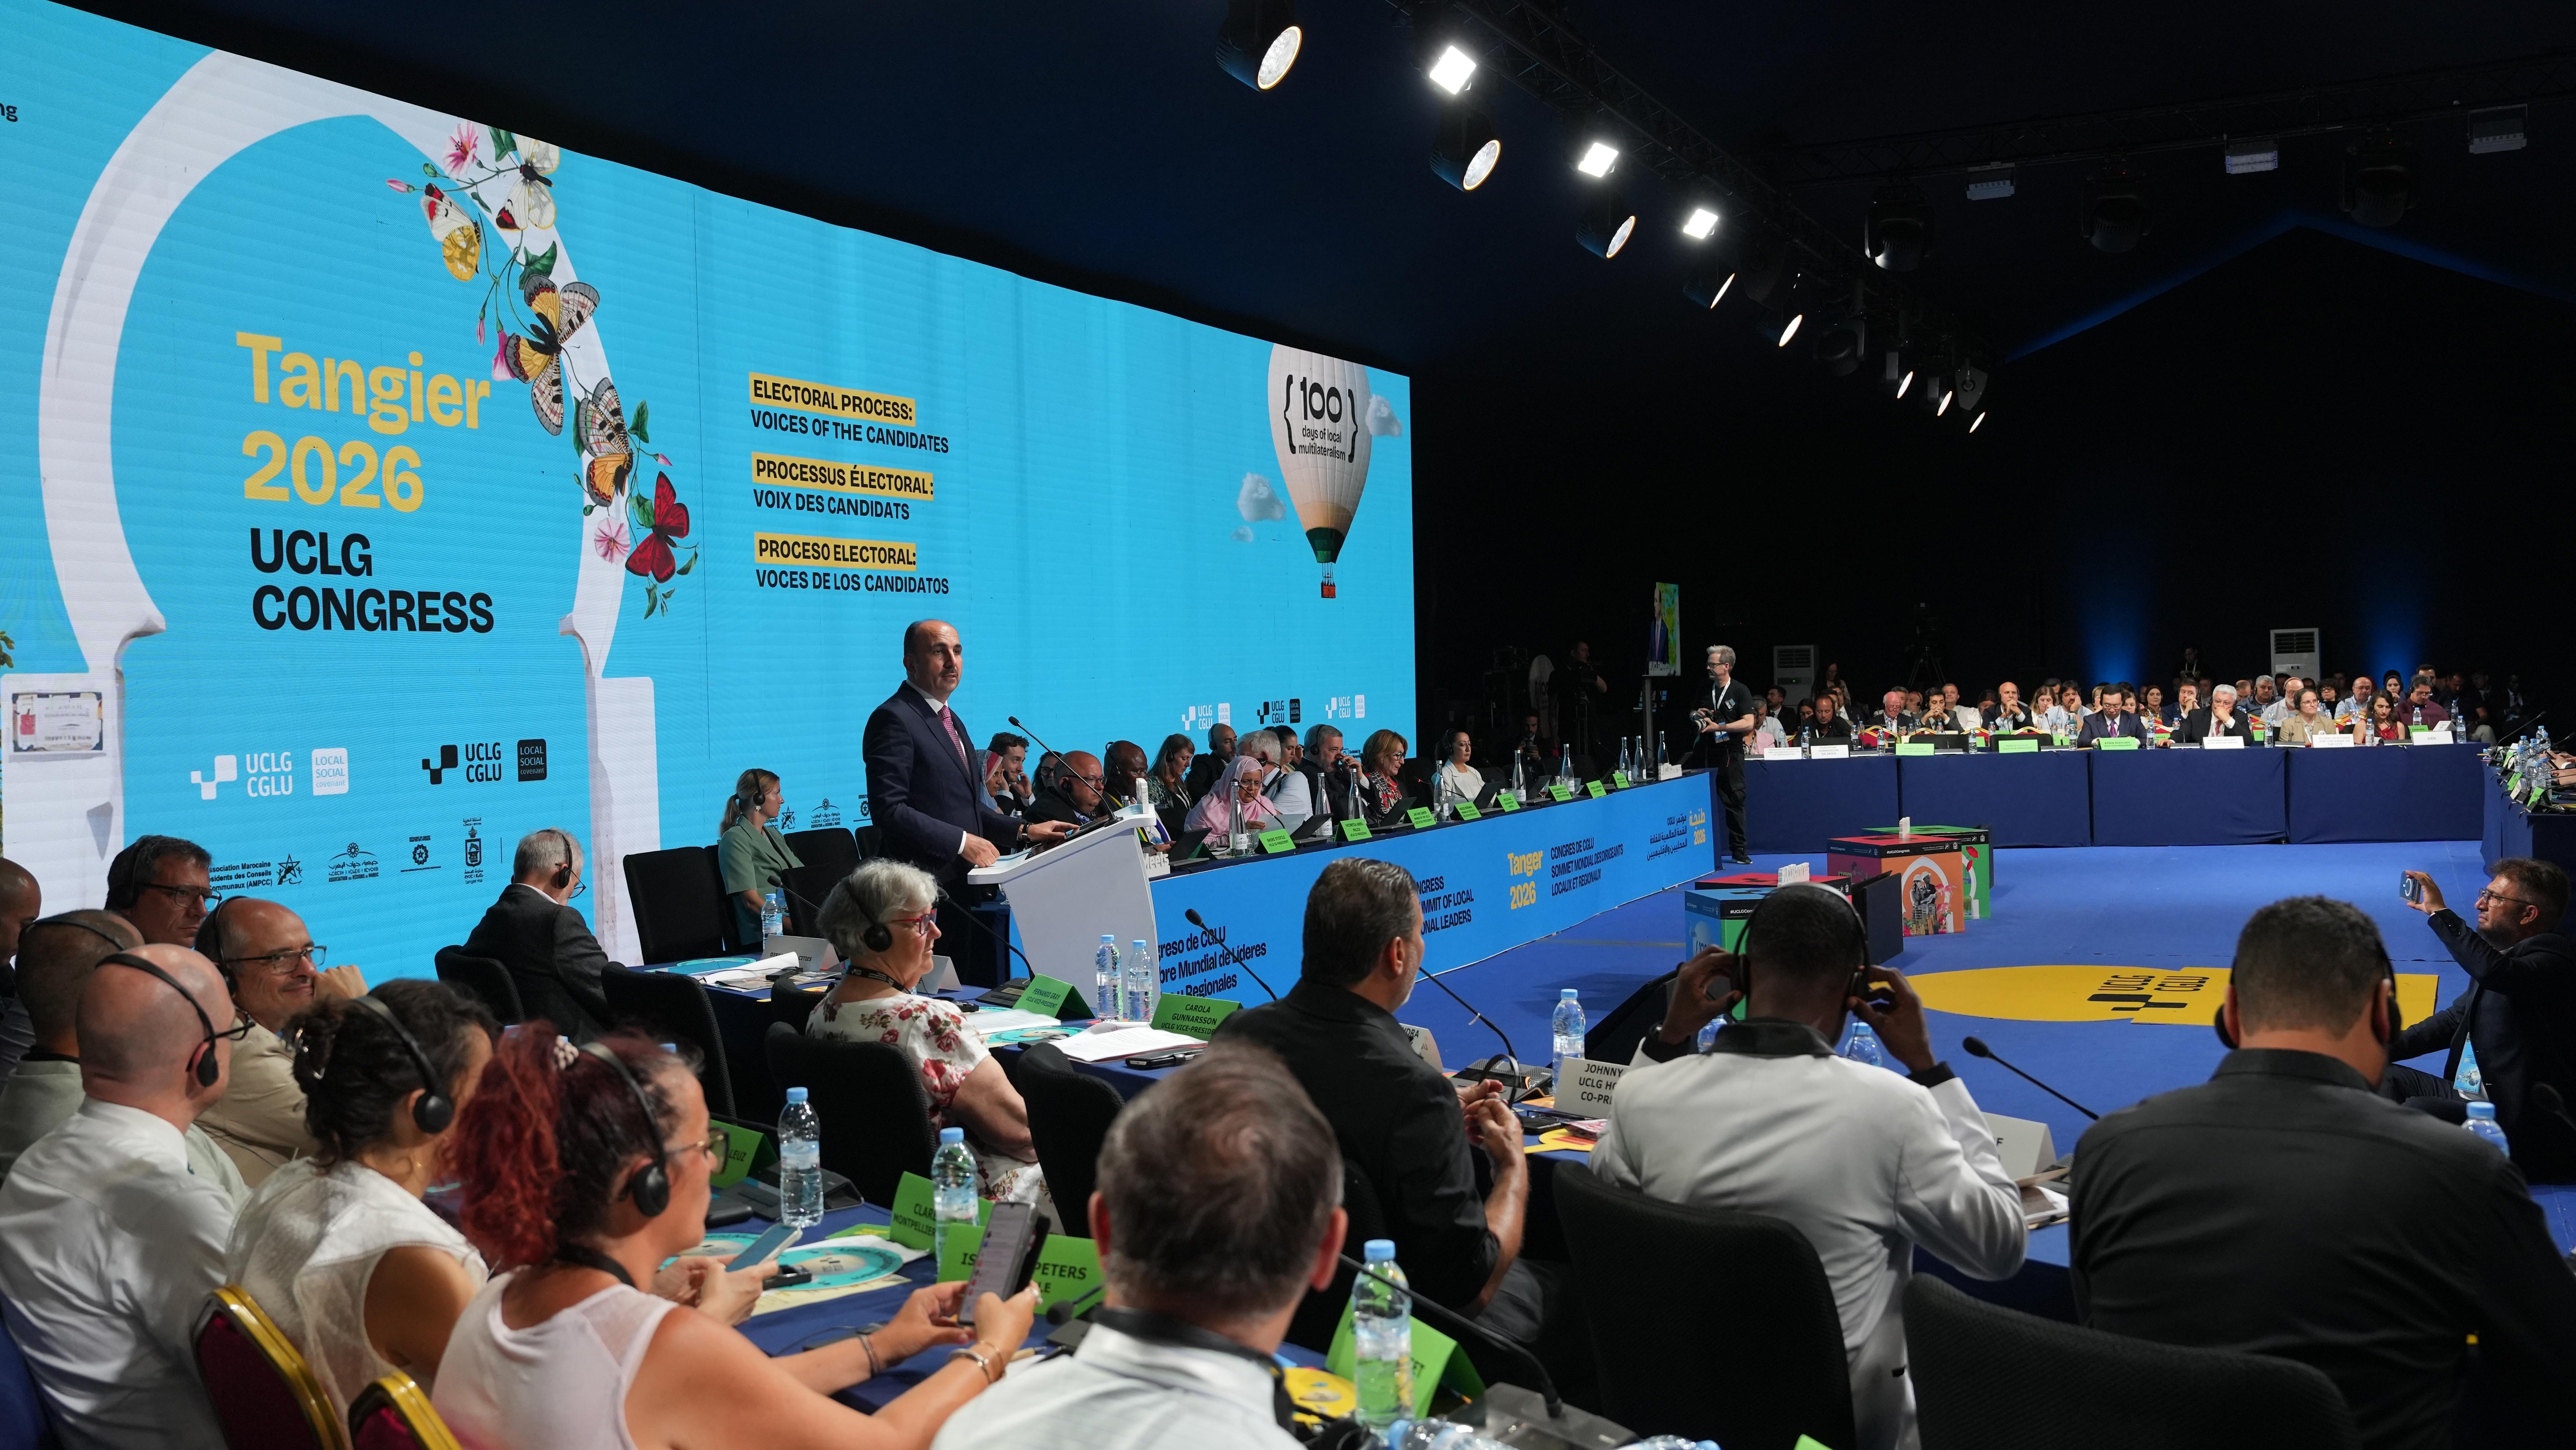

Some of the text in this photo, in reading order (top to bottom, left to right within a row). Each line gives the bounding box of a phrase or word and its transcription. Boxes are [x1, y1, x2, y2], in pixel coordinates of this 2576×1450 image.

[236, 331, 490, 435] Tangier
[754, 379, 913, 421] ELECTORAL PROCESS:
[1300, 376, 1342, 423] 100
[751, 409, 949, 454] VOICES OF THE CANDIDATES
[1302, 425, 1342, 443] days of local
[1299, 443, 1345, 461] multilateralism
[242, 430, 425, 512] 2026
[756, 459, 846, 486] PROCESSUS
[851, 465, 928, 494] ÉLECTORAL
[753, 489, 909, 520] VOIX DES CANDIDATS
[250, 528, 372, 576] UCLG
[759, 539, 916, 566] PROCESO ELECTORAL:
[756, 569, 949, 594] VOCES DE LOS CANDIDATOS
[253, 585, 494, 633] CONGRESS
[1198, 704, 1212, 717] UCLG
[1271, 700, 1284, 711] UCLG
[1339, 696, 1350, 707] UCLG
[1272, 712, 1284, 724] CGLU
[1339, 707, 1350, 718] CGLU
[1198, 718, 1213, 730] CGLU
[315, 756, 344, 765] LOCAL
[465, 742, 501, 762] UCLG
[520, 746, 544, 755] LOCAL
[246, 751, 292, 774] UCLG
[520, 757, 544, 766] SOCIAL
[316, 768, 345, 778] SOCIAL
[466, 763, 502, 783] CGLU
[247, 775, 293, 797] CGLU
[1551, 837, 1594, 860] CONGRES DE CGLU
[209, 861, 271, 873] ssociation Marocaine
[1507, 850, 1543, 877] Tanger
[1551, 860, 1574, 878] SOMMET
[1574, 854, 1594, 872] MONDIAL
[1602, 843, 1623, 862] DIRIGEANTS
[246, 879, 273, 889] (AMPCC)
[247, 870, 272, 878] Conseils
[1552, 868, 1601, 896] LOCAUX ET REGIONAUX
[1443, 894, 1452, 909] OF
[1453, 889, 1474, 906] LOCAL
[1510, 881, 1536, 910] 2026
[1420, 908, 1471, 935] ONAL LEADERS
[1186, 933, 1199, 951] de
[1178, 951, 1217, 979] Mundial
[1219, 949, 1231, 968] de
[1232, 942, 1266, 964] Líderes
[1032, 988, 1051, 999] FERNANDO
[1185, 1004, 1211, 1013] CAROLA
[1172, 1013, 1217, 1025] GUNNARSSON
[1585, 1064, 1624, 1078] JOHNNY
[1579, 1077, 1603, 1089] UCLG
